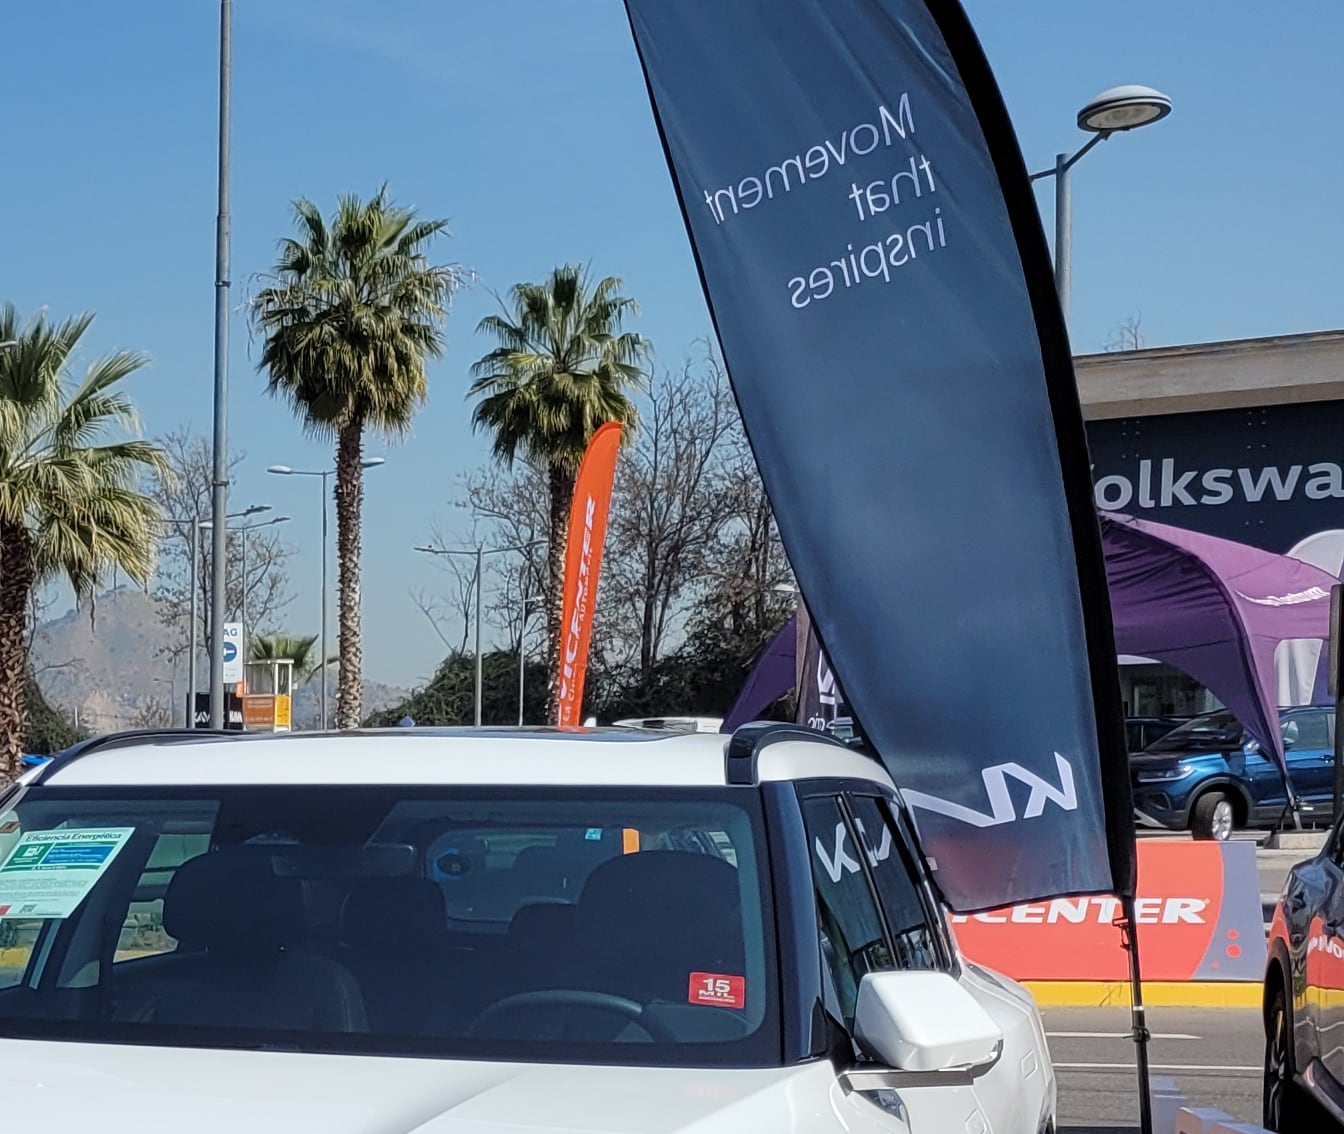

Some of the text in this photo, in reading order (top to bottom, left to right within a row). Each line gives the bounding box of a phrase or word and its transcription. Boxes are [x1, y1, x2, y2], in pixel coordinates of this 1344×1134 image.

[1093, 457, 1344, 511] olkswa
[952, 897, 1207, 924] ENTER
[702, 978, 731, 993] 15
